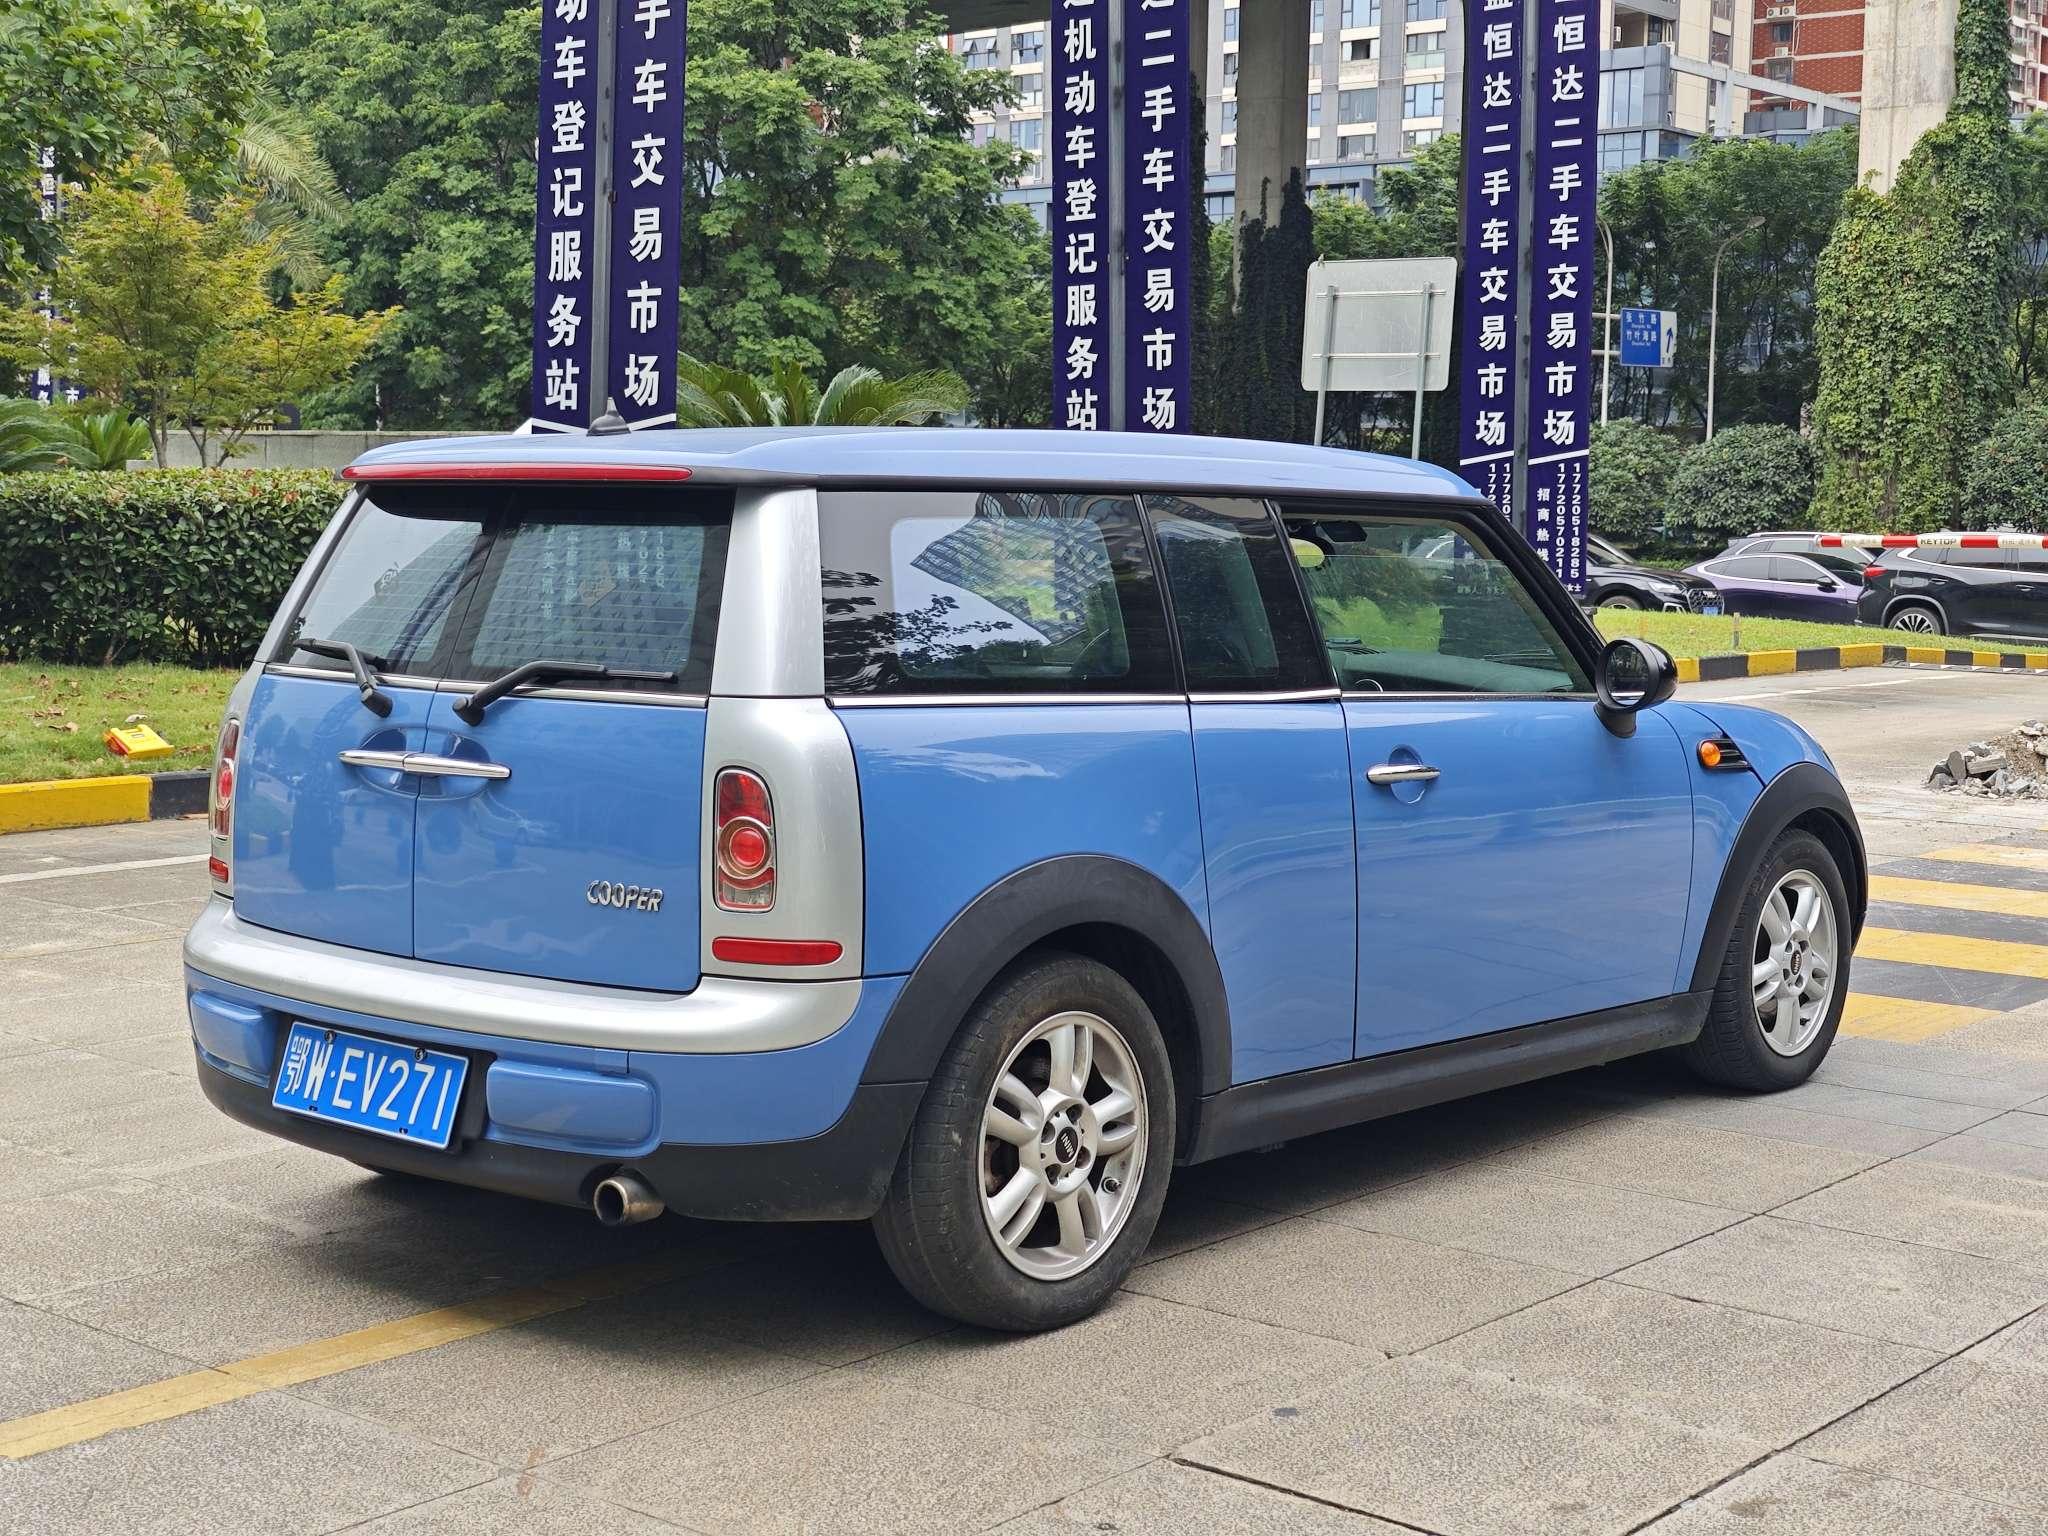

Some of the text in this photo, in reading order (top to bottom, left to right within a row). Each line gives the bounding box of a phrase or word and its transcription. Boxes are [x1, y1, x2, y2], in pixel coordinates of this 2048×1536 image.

[1064, 0, 1099, 431] 机动车登记服务站
[1141, 0, 1177, 430] 二手车交易市场
[1543, 0, 1586, 446] 恒达二手车交易市场
[1555, 462, 1566, 579] 17720570211
[1570, 462, 1582, 579] 17720518285
[586, 880, 663, 912] COOPER
